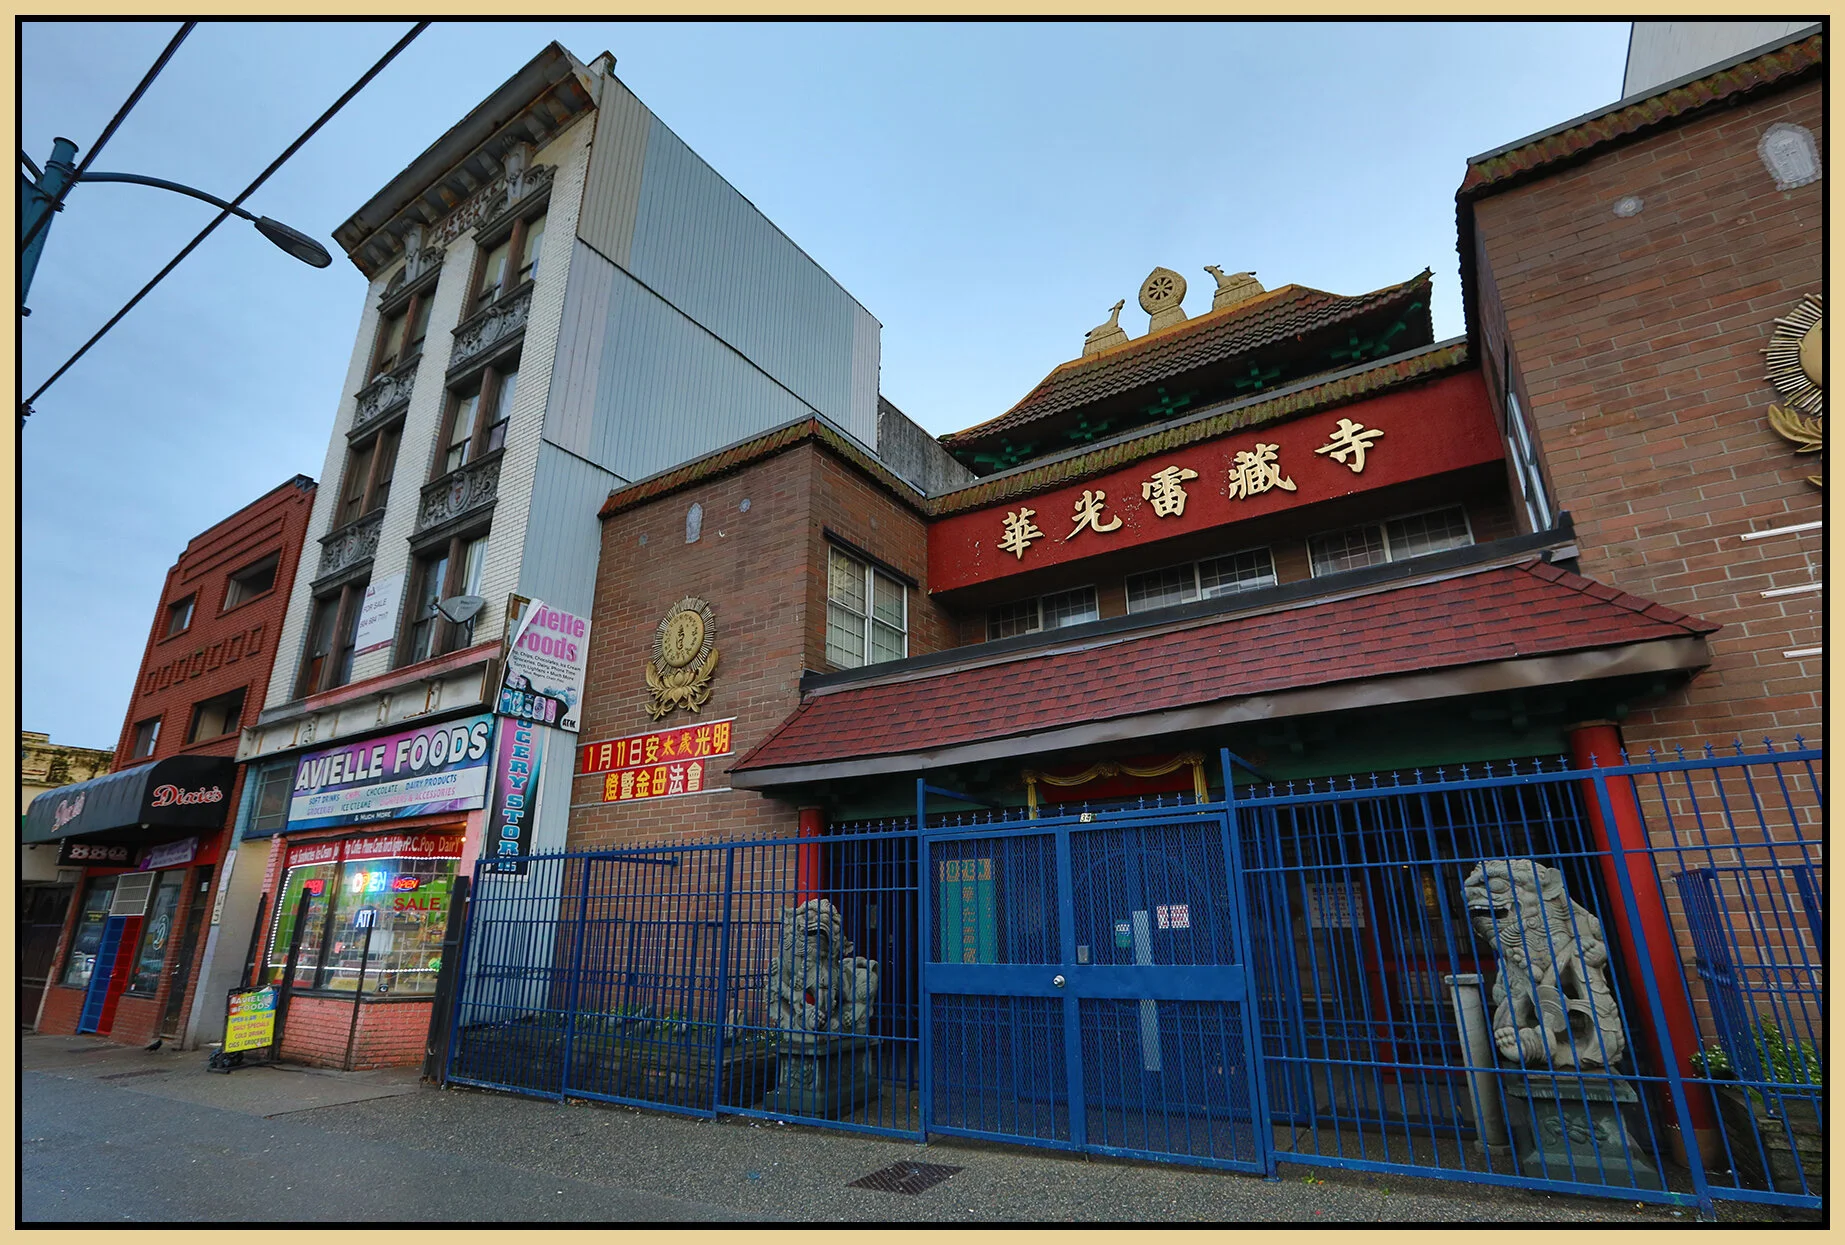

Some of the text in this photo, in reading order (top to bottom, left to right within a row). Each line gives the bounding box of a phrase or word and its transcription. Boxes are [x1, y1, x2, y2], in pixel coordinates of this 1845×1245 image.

[997, 418, 1384, 559] 華光雷藏寺
[374, 597, 387, 610] SALE
[530, 605, 584, 638] ielle
[295, 721, 489, 791] AVIELLE FOODS
[151, 784, 223, 808] Dixie's
[309, 796, 321, 805] SOFT
[322, 794, 340, 803] DRINKS
[366, 784, 398, 797] CHOCOLATE
[405, 780, 424, 791] DAIRY
[424, 774, 457, 787] PRODUCTS
[307, 805, 334, 816] GROCERIES
[341, 803, 350, 811] ICE
[415, 787, 456, 801] ACCESSORIES
[360, 812, 375, 821] MUCH
[376, 811, 391, 819] MORE
[353, 872, 387, 893] OPEN
[393, 878, 419, 889] OPEN
[394, 898, 441, 911] SALE
[238, 1003, 270, 1011] FOODS
